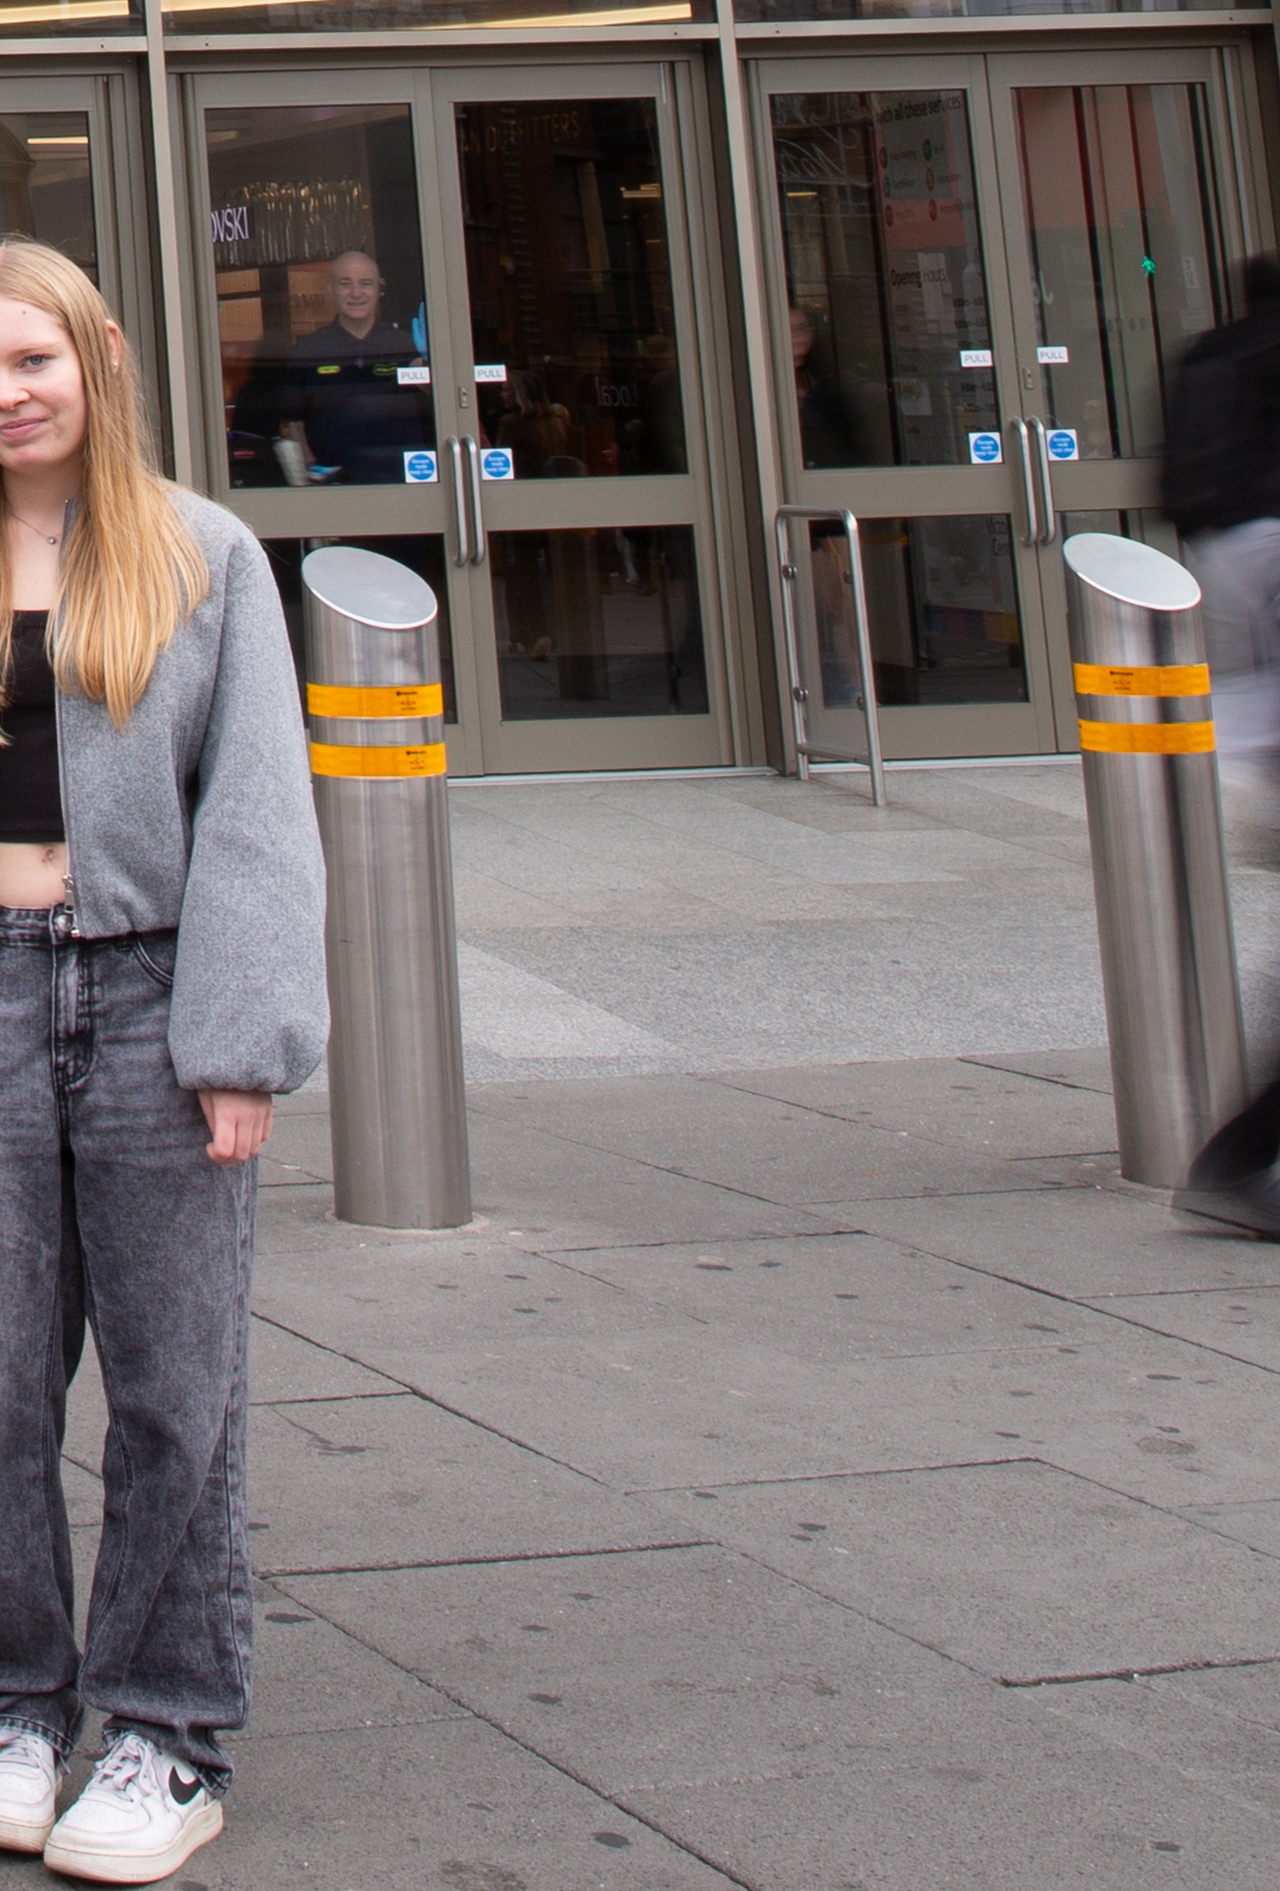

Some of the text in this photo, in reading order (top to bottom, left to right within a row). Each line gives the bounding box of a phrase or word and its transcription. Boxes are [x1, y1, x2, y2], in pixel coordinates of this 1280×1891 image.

[963, 354, 989, 363] PULL
[1040, 350, 1064, 359] PULL
[401, 371, 426, 380] PULL
[477, 369, 502, 378] PULL
